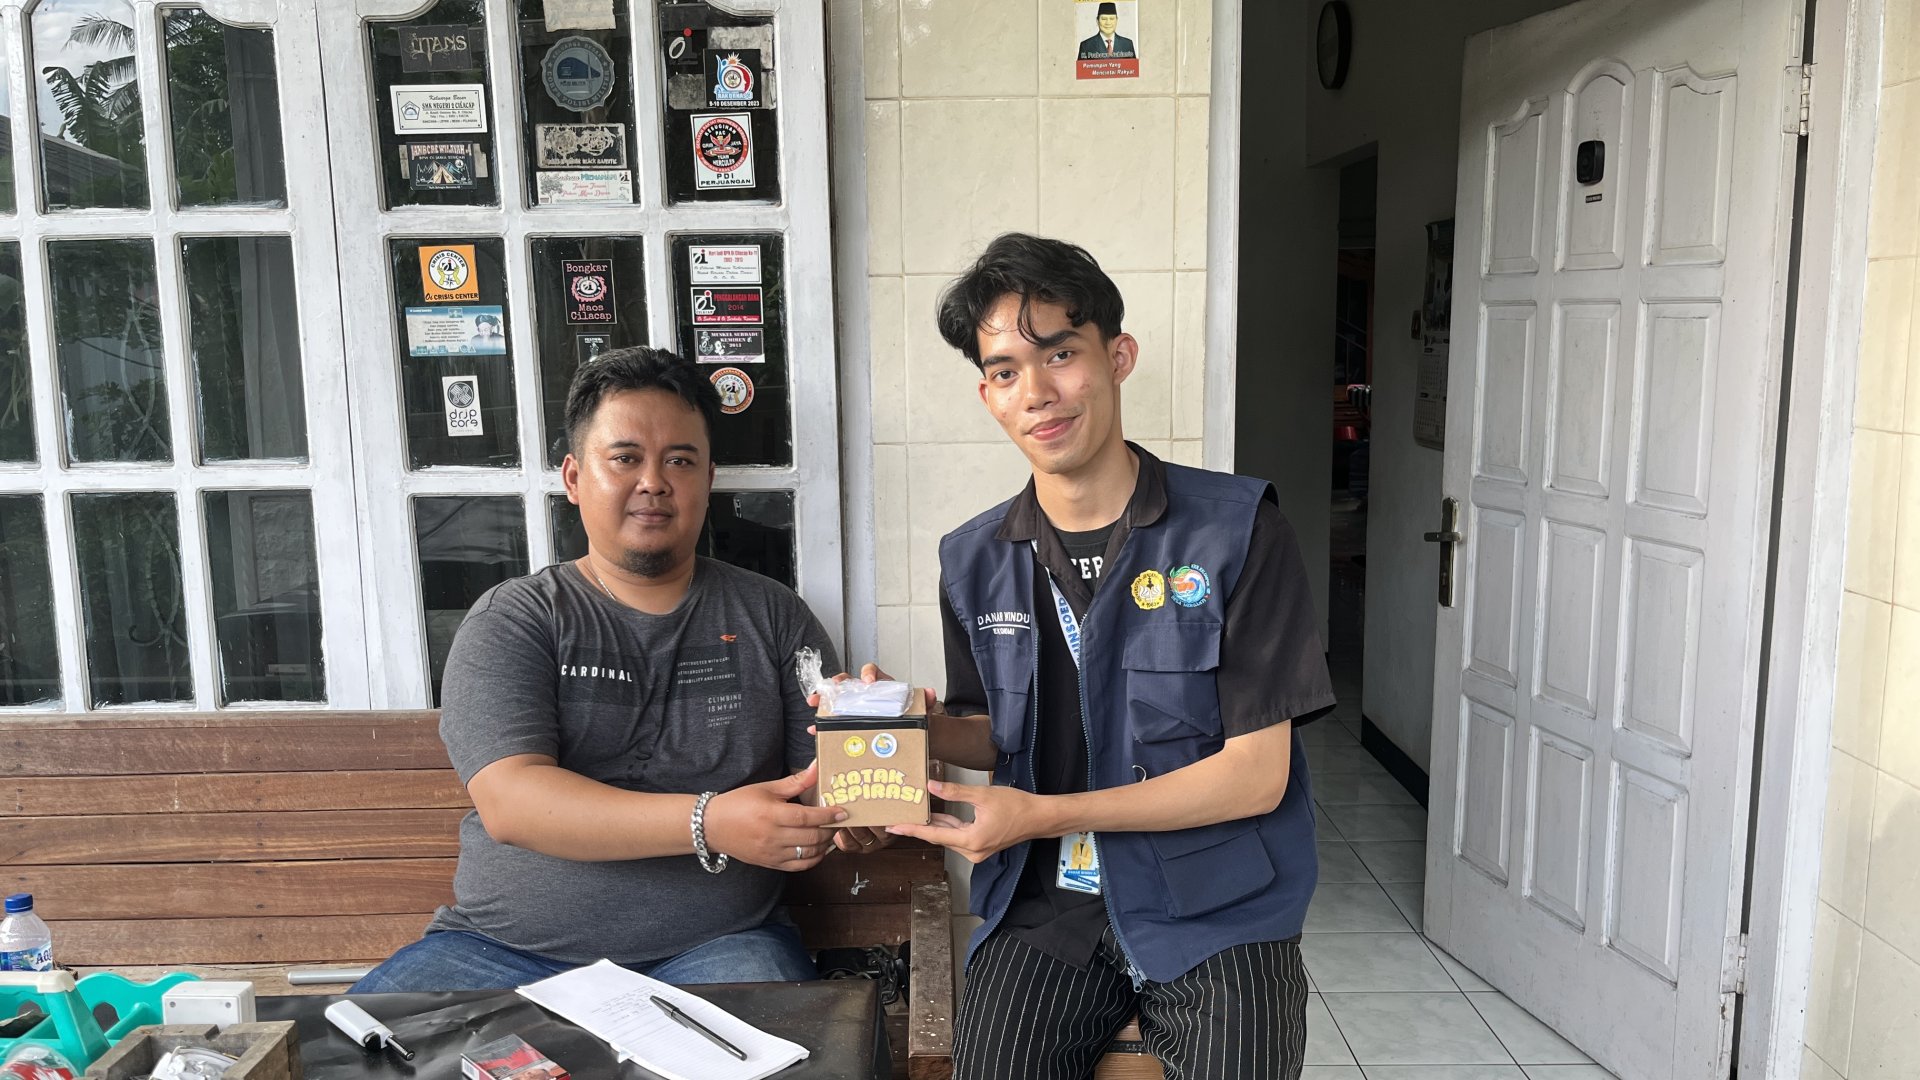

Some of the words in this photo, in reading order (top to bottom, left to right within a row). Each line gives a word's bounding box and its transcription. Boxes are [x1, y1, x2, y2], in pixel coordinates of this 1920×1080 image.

[446, 252, 466, 267] CENTER
[566, 263, 608, 274] Bongkar
[570, 311, 612, 321] Cilacap
[1003, 612, 1030, 624] WINDU
[561, 664, 633, 682] CARDINAL
[708, 693, 742, 704] CLIMBING
[708, 705, 716, 713] IS
[717, 704, 727, 712] MY
[831, 768, 906, 790] KOTAK
